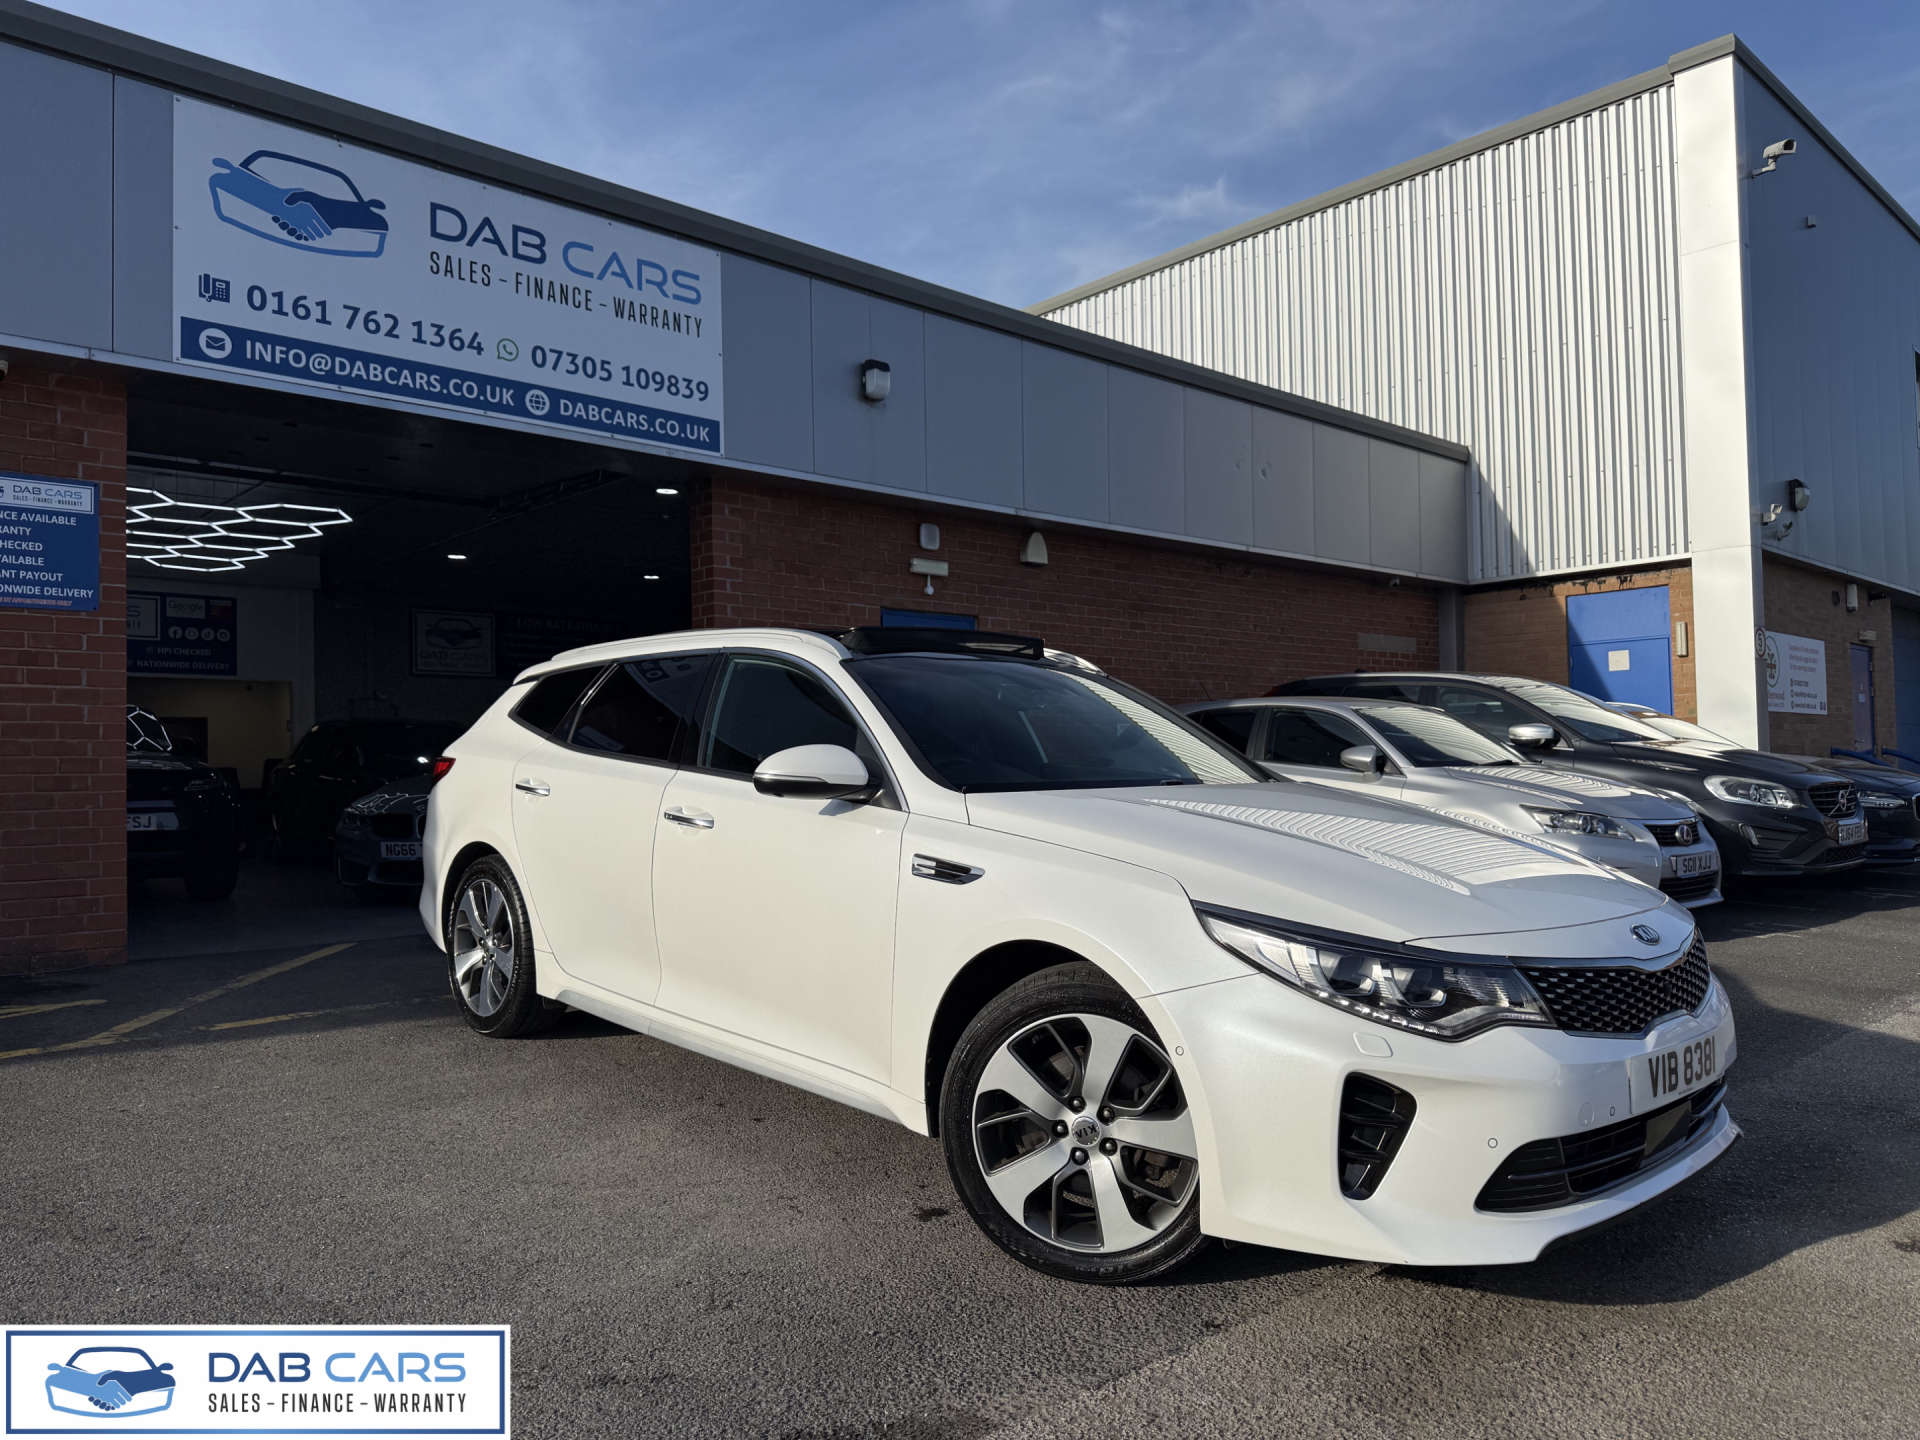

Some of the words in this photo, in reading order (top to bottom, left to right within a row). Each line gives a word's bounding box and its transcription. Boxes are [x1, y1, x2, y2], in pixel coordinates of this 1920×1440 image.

[430, 201, 547, 265] DAB
[562, 241, 701, 305] CARS
[430, 251, 491, 287] SALES
[515, 272, 593, 311] FINANCE
[613, 296, 702, 338] WARRANTY
[246, 284, 332, 326] 0161
[342, 304, 400, 340] 762
[411, 320, 484, 356] 1364
[531, 345, 612, 382] 07305
[621, 365, 709, 402] 109839
[246, 339, 515, 407] INFO@DABCARS.CO.UK
[560, 399, 710, 442] DABCARS.CO.UK
[13, 485, 41, 495] DAB
[45, 488, 82, 499] CARS
[20, 512, 77, 526] AVAILABLE
[0, 525, 31, 536] ANTY
[0, 554, 45, 566] AILABLE
[0, 569, 16, 579] NT
[20, 570, 64, 582] PAYOUT
[44, 586, 94, 599] DELIVERY
[1648, 1050, 1678, 1098] VIB
[1683, 1036, 1716, 1086] 8381
[1075, 1124, 1097, 1138] KIA
